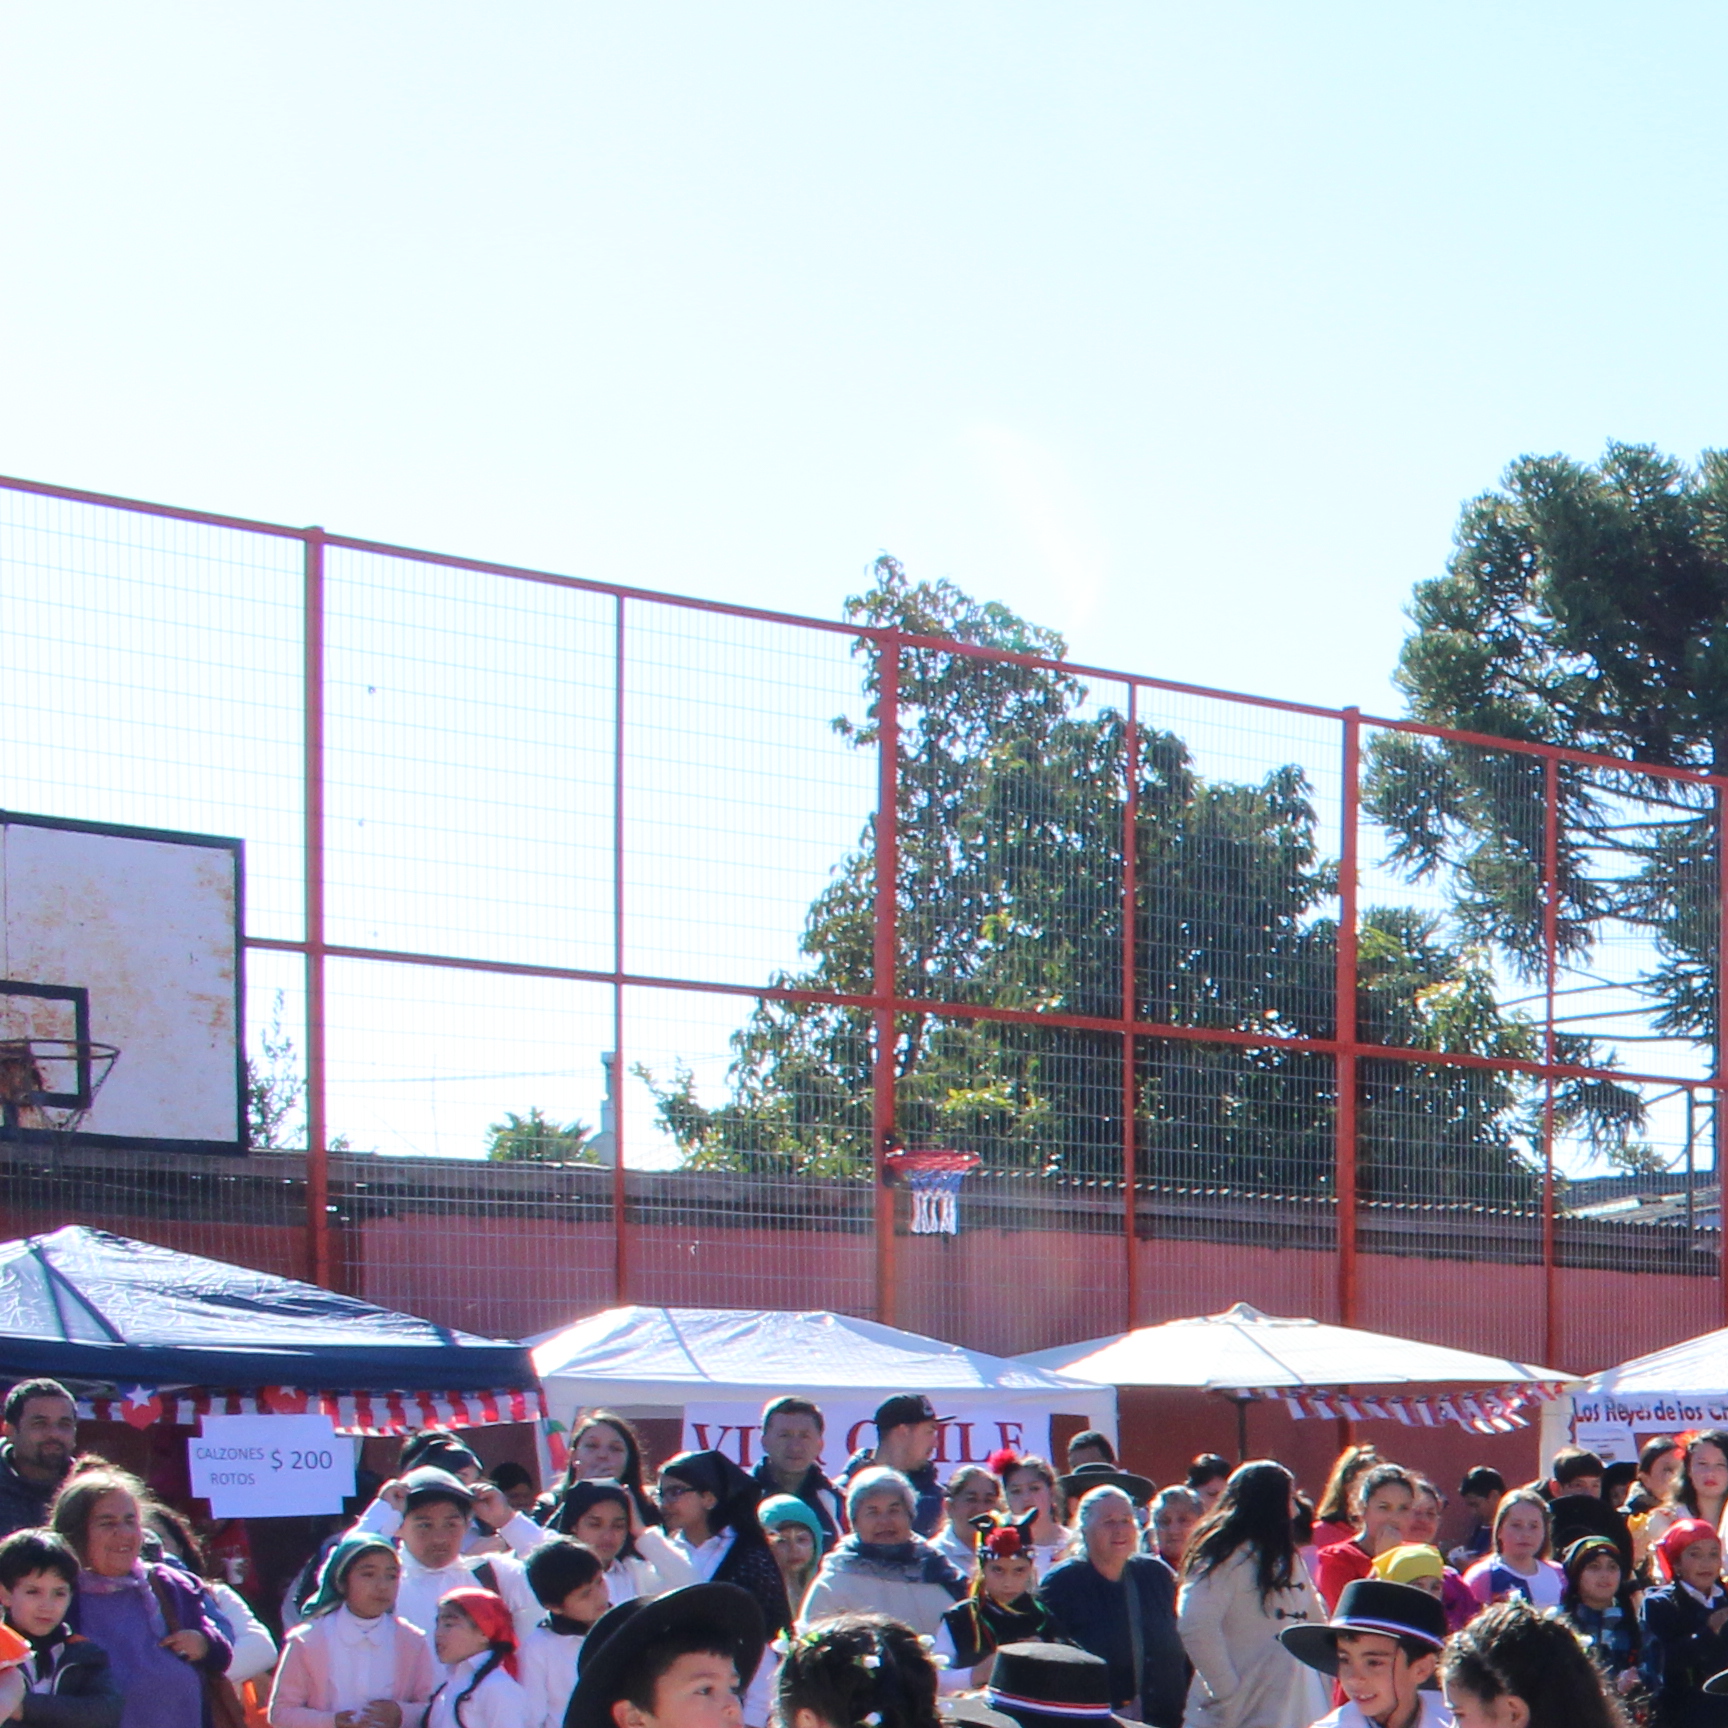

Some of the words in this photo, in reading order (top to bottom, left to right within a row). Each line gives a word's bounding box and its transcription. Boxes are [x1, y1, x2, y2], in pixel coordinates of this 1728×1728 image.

[1572, 1396, 1599, 1422] Los
[1654, 1399, 1676, 1421] de
[196, 1447, 265, 1461] CALZONES
[271, 1449, 283, 1472] $
[291, 1450, 333, 1470] 200
[211, 1473, 255, 1486] ROTOS
